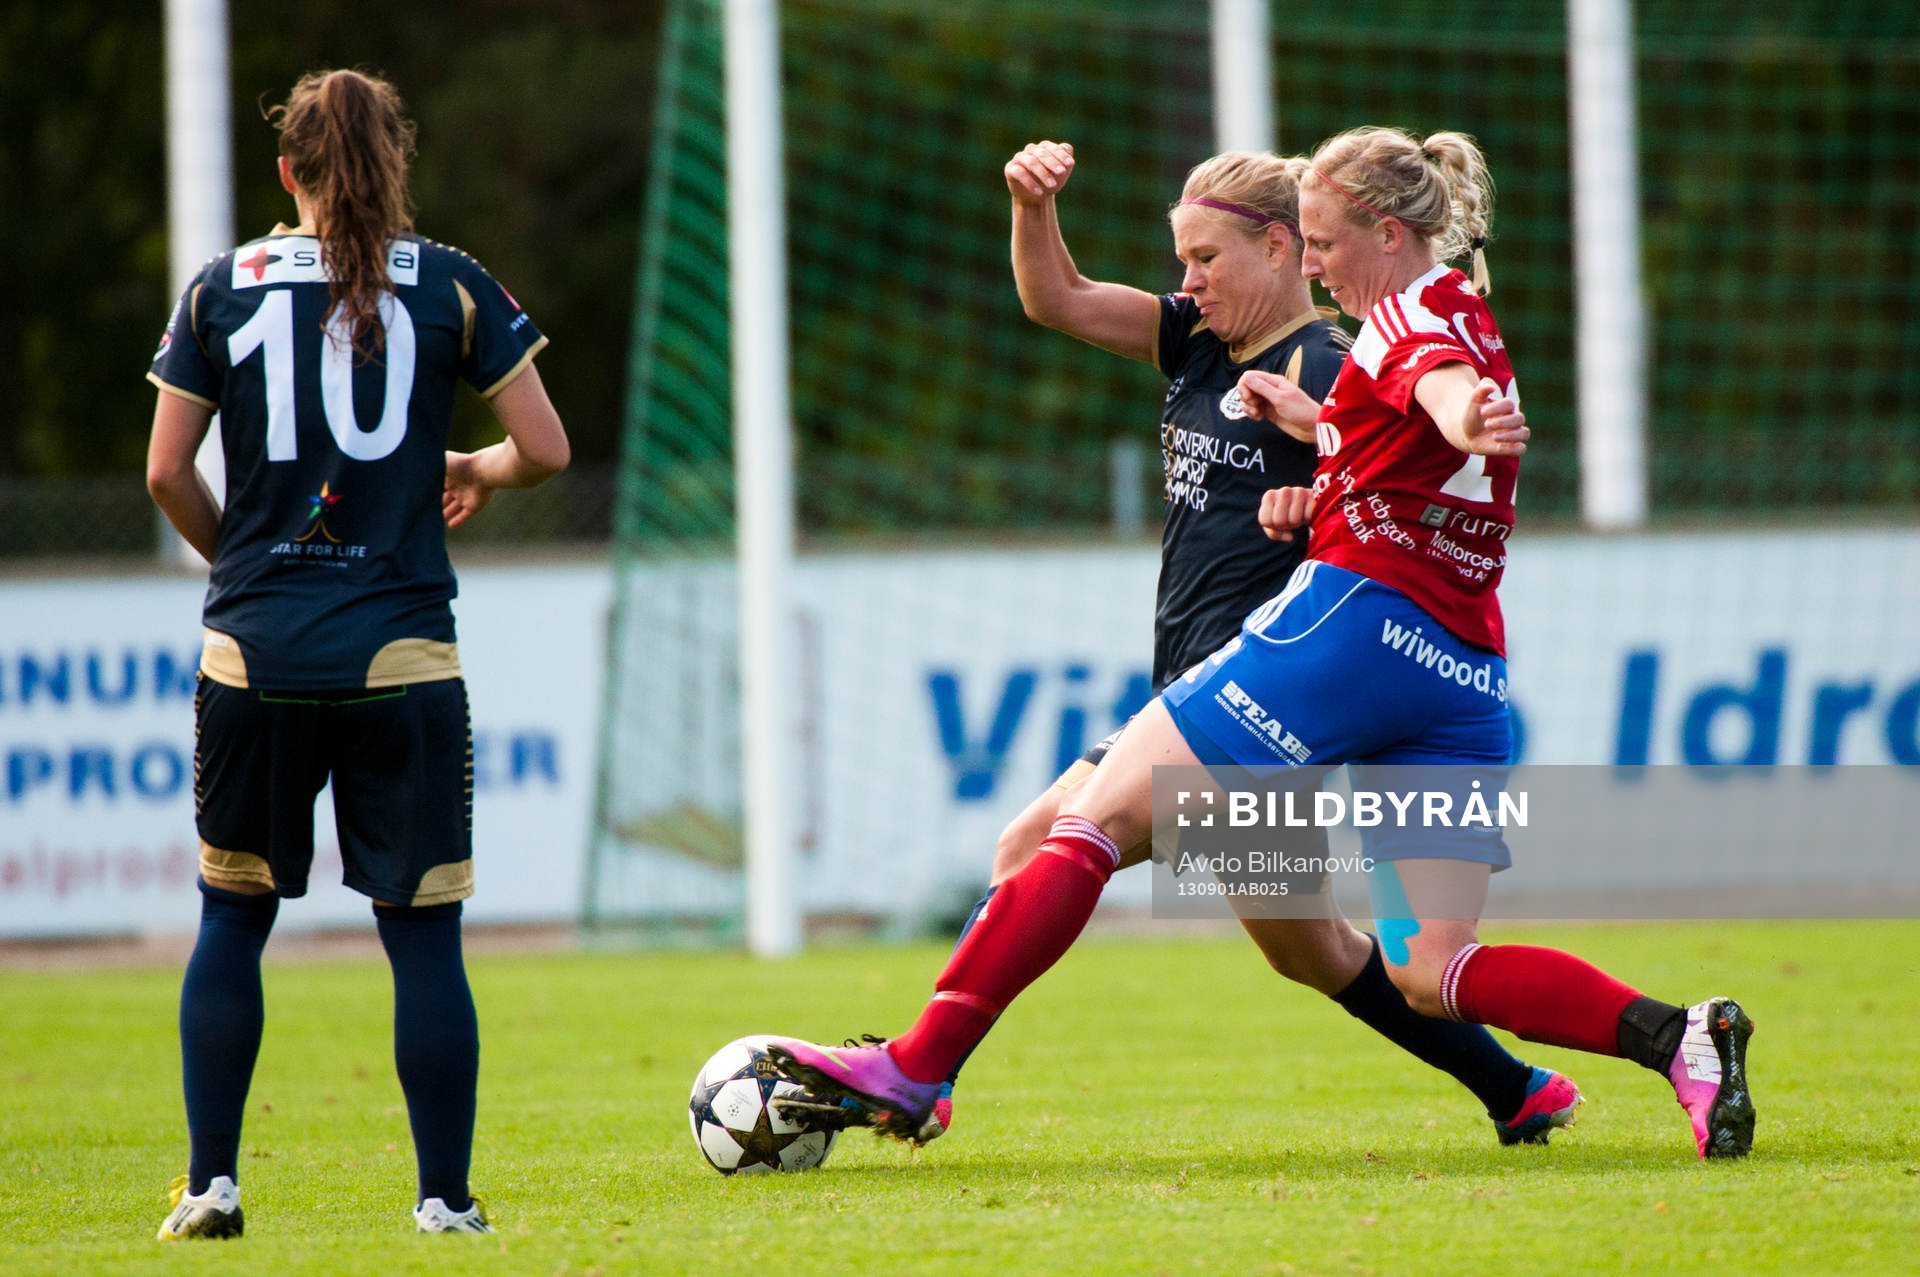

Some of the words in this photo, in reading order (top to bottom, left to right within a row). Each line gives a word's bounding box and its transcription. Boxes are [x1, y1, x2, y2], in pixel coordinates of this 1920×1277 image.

[227, 289, 416, 462] 10
[1161, 423, 1265, 473] FÖRVERKLIGA
[306, 544, 334, 556] FOR
[337, 545, 367, 558] LIFE
[1381, 618, 1508, 706] wiwood.s
[1225, 683, 1306, 758] PEAB
